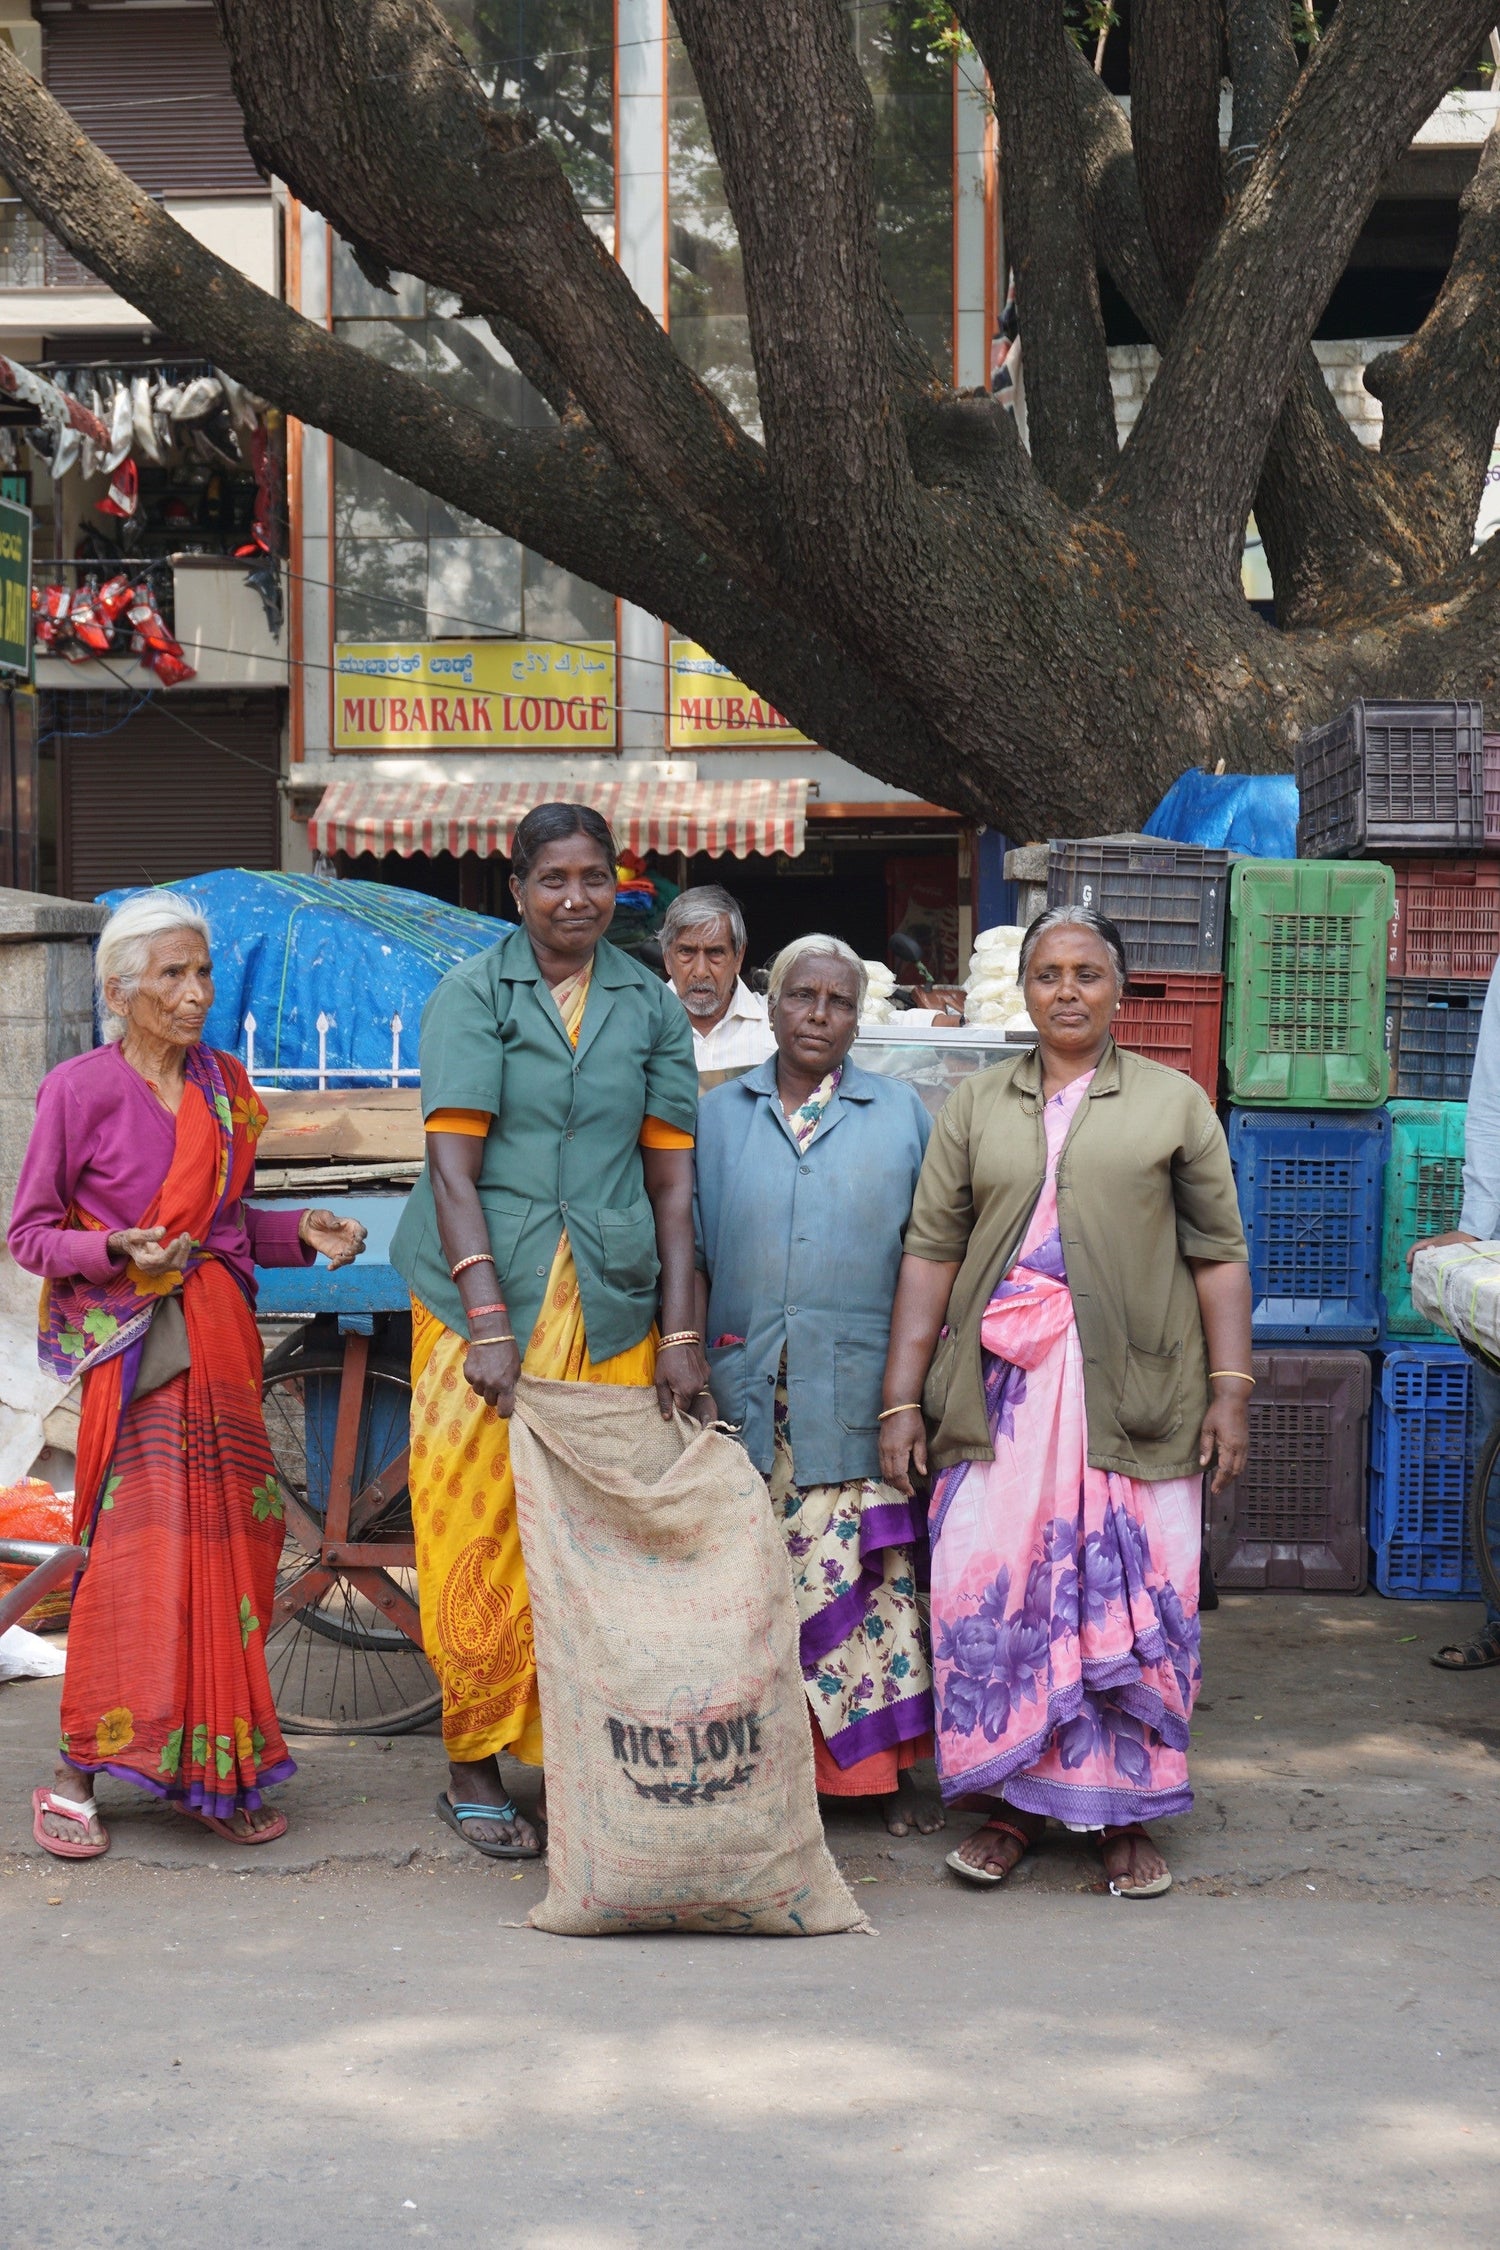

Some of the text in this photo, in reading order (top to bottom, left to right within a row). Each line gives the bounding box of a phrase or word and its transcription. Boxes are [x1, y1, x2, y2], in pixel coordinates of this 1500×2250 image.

[343, 696, 609, 732] MUBARAK LODGE
[607, 1712, 762, 1769] RICE LOVE
